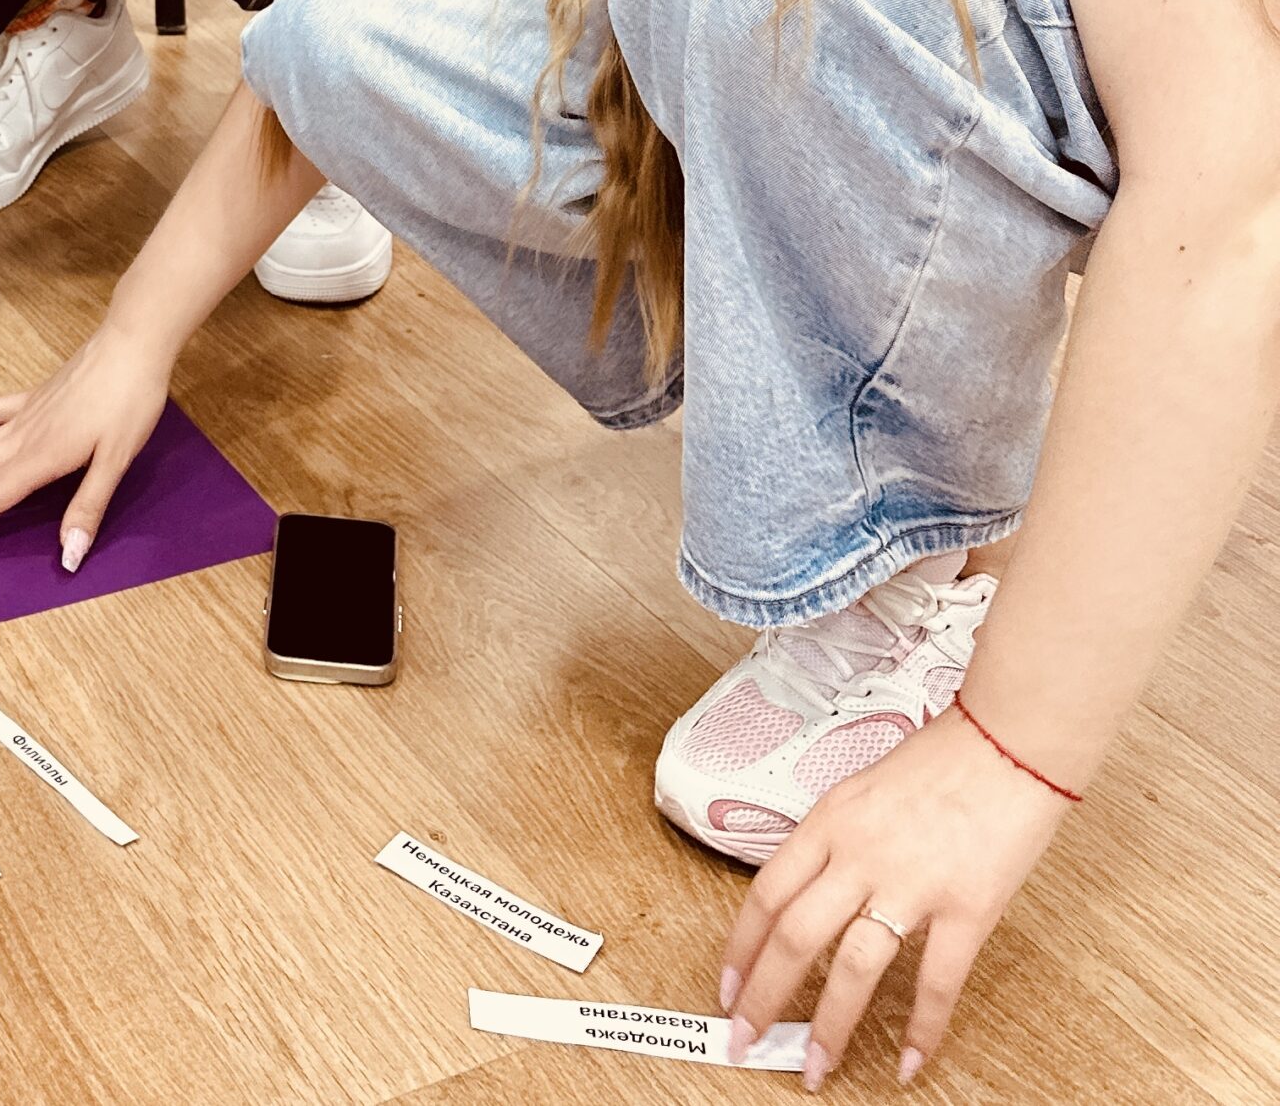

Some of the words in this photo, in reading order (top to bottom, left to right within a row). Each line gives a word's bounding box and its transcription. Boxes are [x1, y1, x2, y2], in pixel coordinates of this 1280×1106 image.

[13, 734, 69, 786] Филиалы
[402, 841, 493, 899] Немецкая
[494, 896, 590, 948] молодежь
[428, 879, 533, 943] Казахстана
[579, 1006, 709, 1034] Казахстана
[585, 1028, 707, 1055] Молодежь
